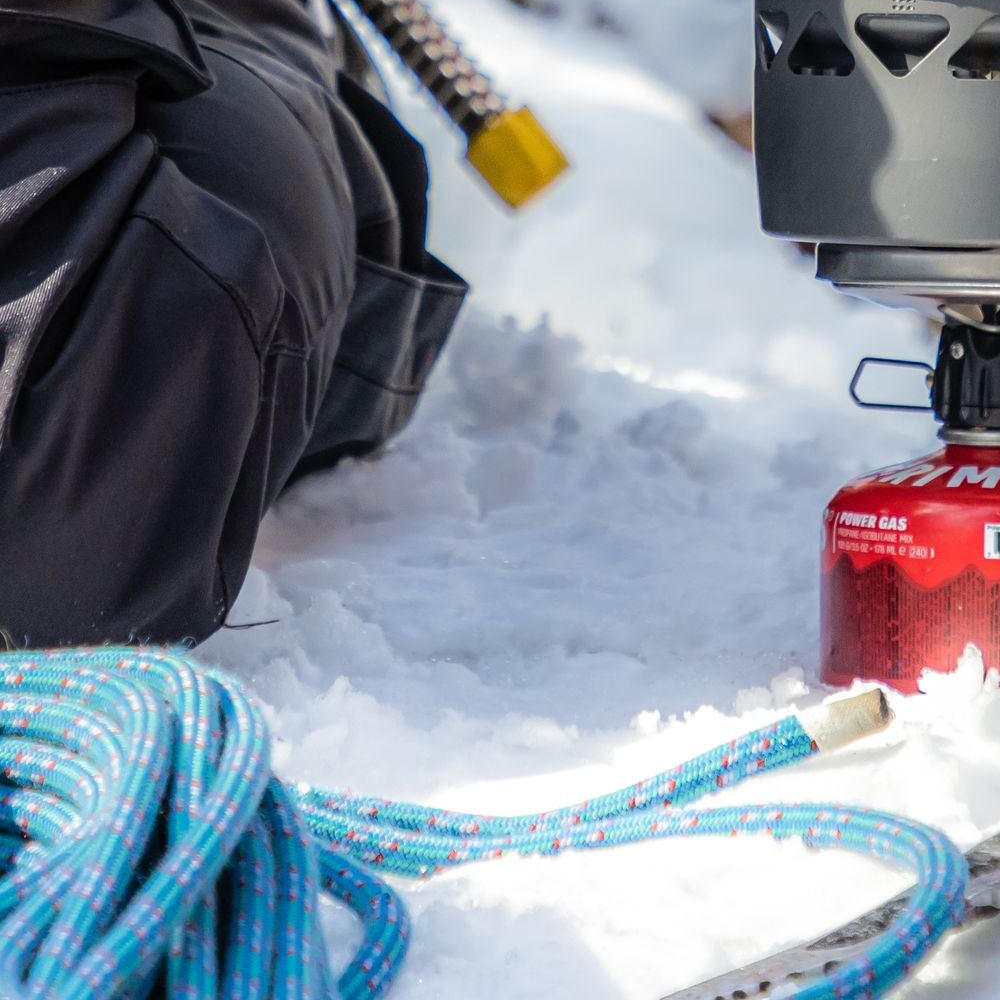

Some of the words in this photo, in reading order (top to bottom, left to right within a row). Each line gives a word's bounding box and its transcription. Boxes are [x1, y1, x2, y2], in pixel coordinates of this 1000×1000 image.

[839, 511, 877, 529] POWER
[878, 515, 907, 532] GAS
[899, 534, 914, 544] MIX
